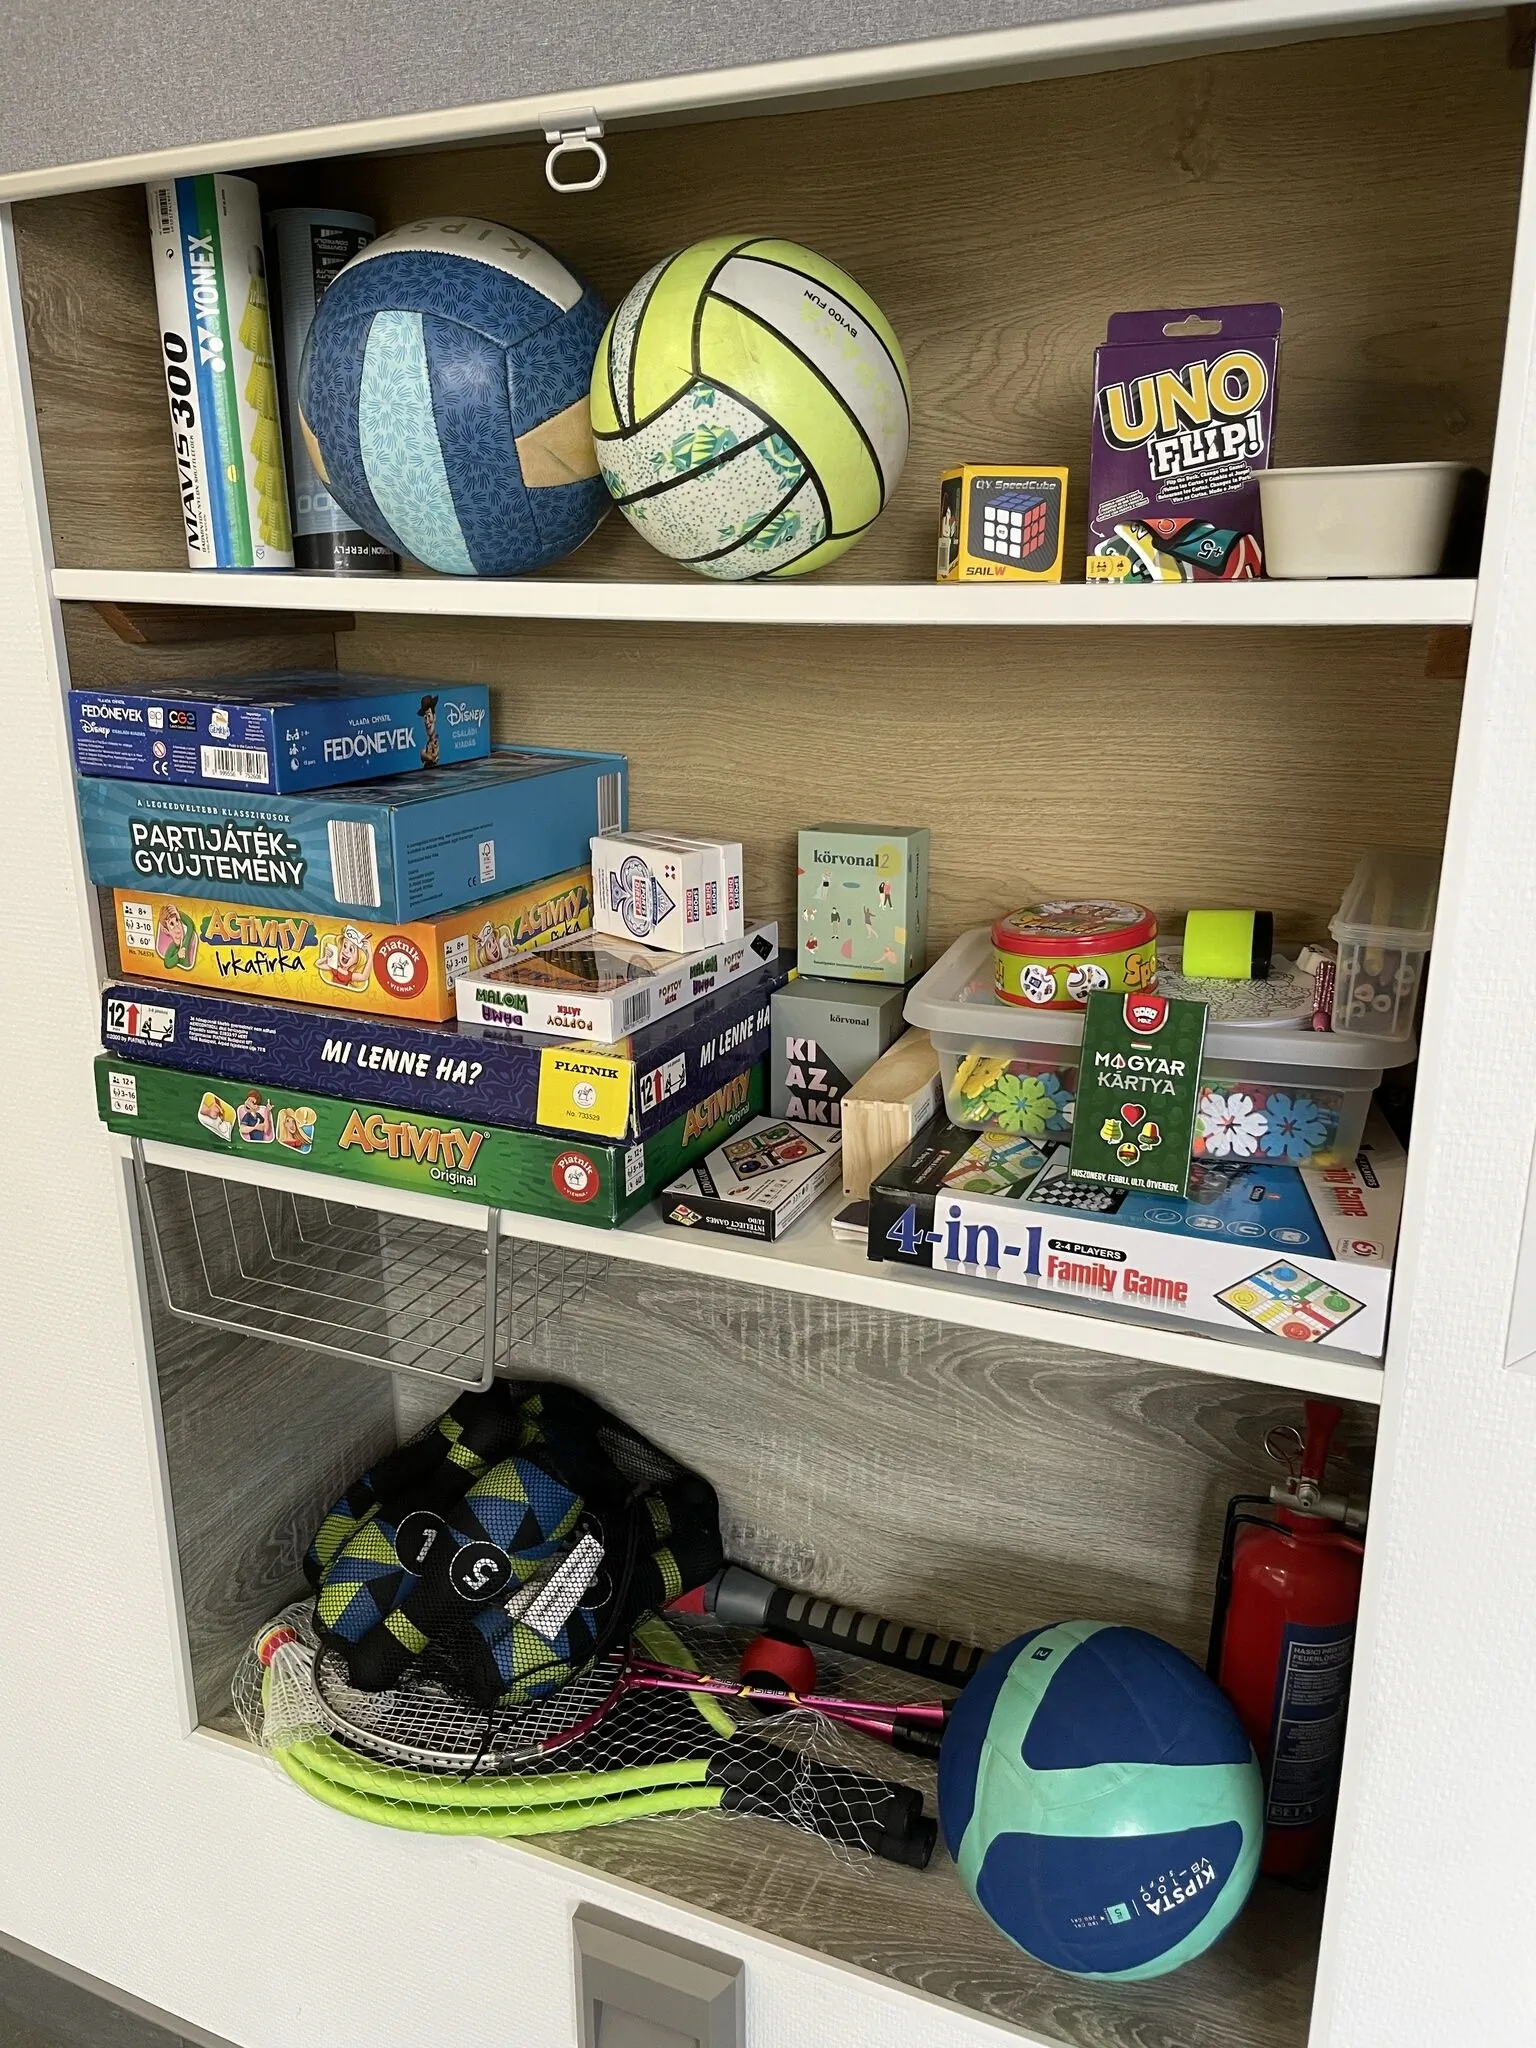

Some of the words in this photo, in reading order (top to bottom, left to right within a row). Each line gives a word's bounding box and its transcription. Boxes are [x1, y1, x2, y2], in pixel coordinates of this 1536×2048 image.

[187, 234, 217, 320] YONEX
[803, 289, 828, 312] FUN
[827, 304, 859, 338] BV100
[164, 331, 196, 428] 300
[1102, 351, 1267, 449] UNO
[1153, 414, 1263, 476] FLIP!
[174, 430, 202, 551] MAVIS
[976, 480, 993, 491] QY
[994, 480, 1056, 491] SpeedCube
[333, 545, 369, 555] PERFLY
[81, 703, 144, 723] FEDŐNEVEK
[323, 727, 417, 763] FEDŐNEVEK
[454, 738, 477, 750] KIADÁS
[137, 799, 143, 807] A
[146, 800, 219, 814] LEGKEDVELTEBB
[221, 808, 291, 823] KLASSZIKUSOK
[132, 823, 297, 857] PARTIJÁTÉK-
[135, 846, 304, 885] GYŰJTEMÉNY
[634, 881, 642, 915] DIRECT
[138, 908, 147, 916] 8+
[517, 885, 584, 937] ACTIVITY
[136, 922, 152, 932] 3-10
[204, 906, 309, 952] ACTIVITY
[379, 938, 421, 964] Piatnik
[456, 941, 464, 950] 8+
[724, 949, 745, 967] POPTOY
[216, 946, 305, 978] Irkafirka
[454, 955, 468, 967] 3-10
[689, 954, 719, 980] MALOM
[389, 983, 415, 993] VIENNA
[476, 987, 529, 1014] MALOM
[658, 980, 682, 998] POPTOY
[108, 1001, 125, 1028] 12
[482, 1003, 523, 1026] DÁMA
[547, 1014, 594, 1032] POPTOY
[829, 1014, 870, 1027] körvonal
[120, 1035, 127, 1043] by
[146, 1039, 163, 1049] Vienna
[559, 1046, 626, 1060] PIATNIK
[700, 1041, 716, 1068] MI
[719, 1023, 754, 1054] LENNE
[785, 1036, 817, 1062] KI
[320, 1038, 352, 1065] MI
[356, 1042, 432, 1078] LENNE
[435, 1056, 484, 1086] HA?
[554, 1060, 620, 1079] PIATNIK
[1095, 1051, 1186, 1078] MAGYAR
[121, 1077, 134, 1087] 12+
[641, 1075, 653, 1110] 12
[785, 1064, 839, 1098] AZ,
[1097, 1071, 1176, 1097] KÁRTYA
[120, 1090, 136, 1099] 3-16
[566, 1110, 578, 1119] No.
[578, 1111, 601, 1122] 733529
[681, 1069, 752, 1147] ACTIVITY
[728, 1102, 750, 1127] Original
[338, 1108, 485, 1172] ACTIVITY
[430, 1166, 478, 1188] Original
[558, 1154, 594, 1176] Piatnik
[1070, 1168, 1107, 1182] HUSZONEGY,
[1107, 1175, 1131, 1187] FERBLI,
[1130, 1178, 1146, 1188] ULTI,
[567, 1189, 588, 1198] VIENNA
[1333, 1186, 1369, 1218] Game
[705, 1216, 730, 1228] GAMES
[747, 1217, 765, 1226] LUDO
[885, 1203, 1044, 1277] 4-in-1
[1055, 1240, 1071, 1251] 2-4
[1073, 1243, 1122, 1261] PLAYERS
[1047, 1255, 1118, 1294] Family
[1123, 1267, 1189, 1302] Game
[1145, 1864, 1215, 1916] KIPSTA
